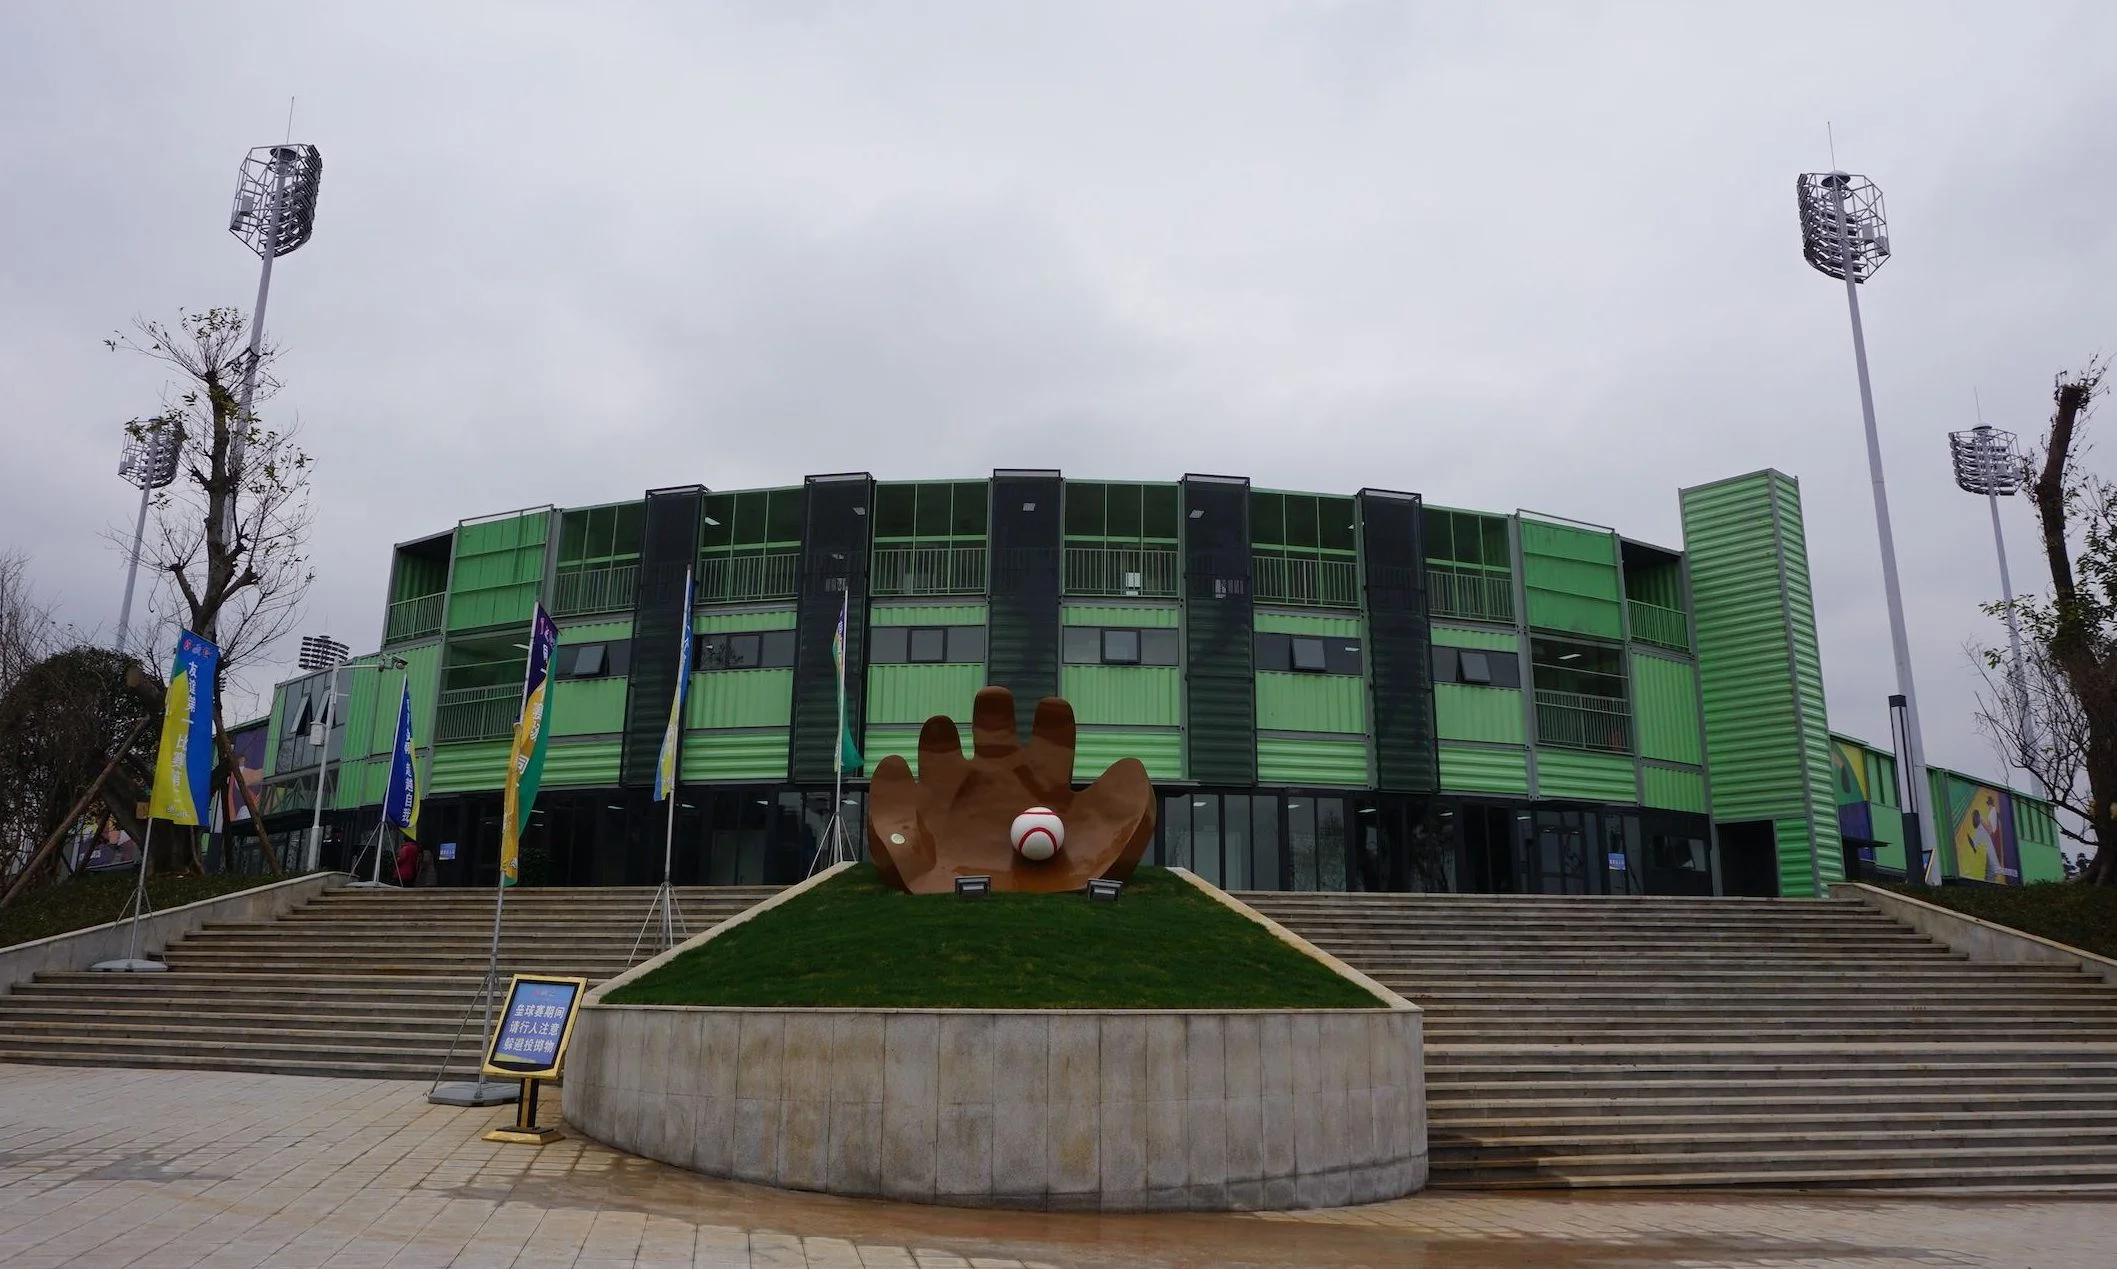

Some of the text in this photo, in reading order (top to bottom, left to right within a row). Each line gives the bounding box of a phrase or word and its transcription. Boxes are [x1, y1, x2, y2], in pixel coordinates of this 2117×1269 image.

[514, 1004, 566, 1019] 垒球赛期间
[509, 1020, 560, 1036] 请行人注意
[503, 1037, 555, 1053] 躲避投掷物
